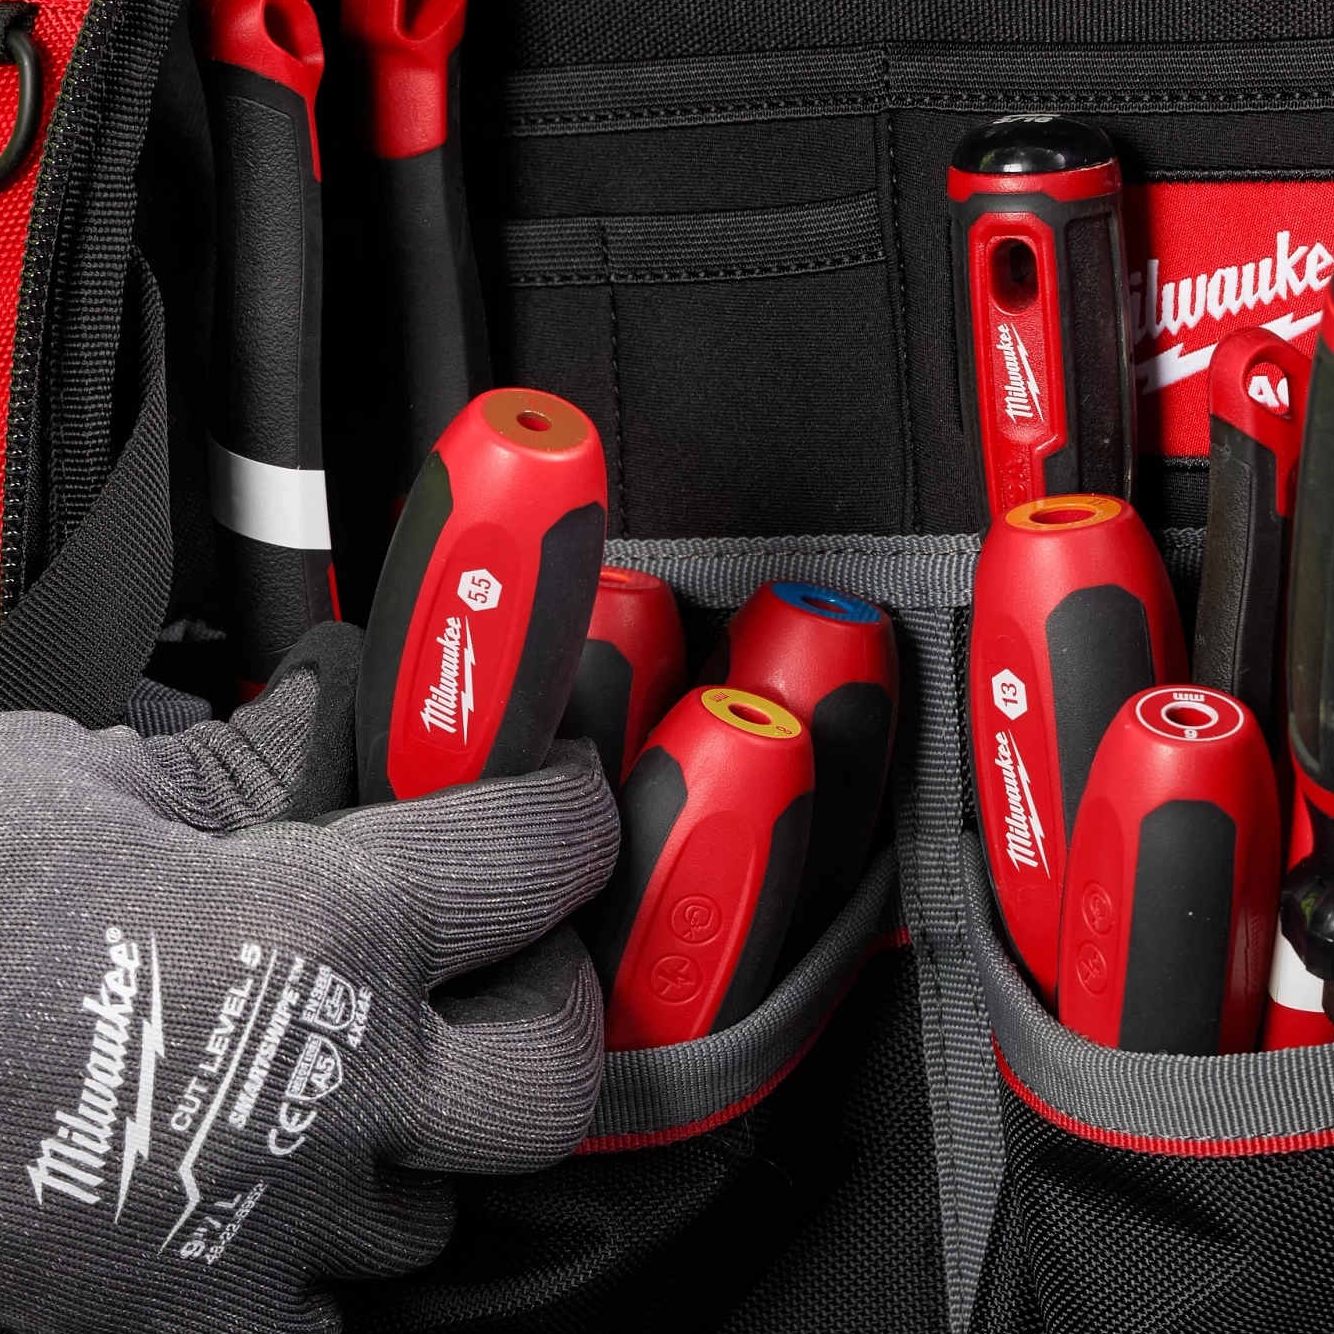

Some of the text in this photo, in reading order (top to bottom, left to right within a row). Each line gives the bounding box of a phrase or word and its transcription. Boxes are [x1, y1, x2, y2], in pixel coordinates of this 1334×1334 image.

[1004, 322, 1034, 423] Milwaukee
[468, 576, 492, 604] 5.5
[420, 617, 462, 734] Milwaukee
[1001, 682, 1018, 707] 13
[995, 730, 1039, 872] Milwaukee
[300, 965, 333, 1024] EN388
[171, 943, 262, 1132] CUT LEVEL 5
[310, 1055, 336, 1090] A5
[214, 1193, 242, 1208] L
